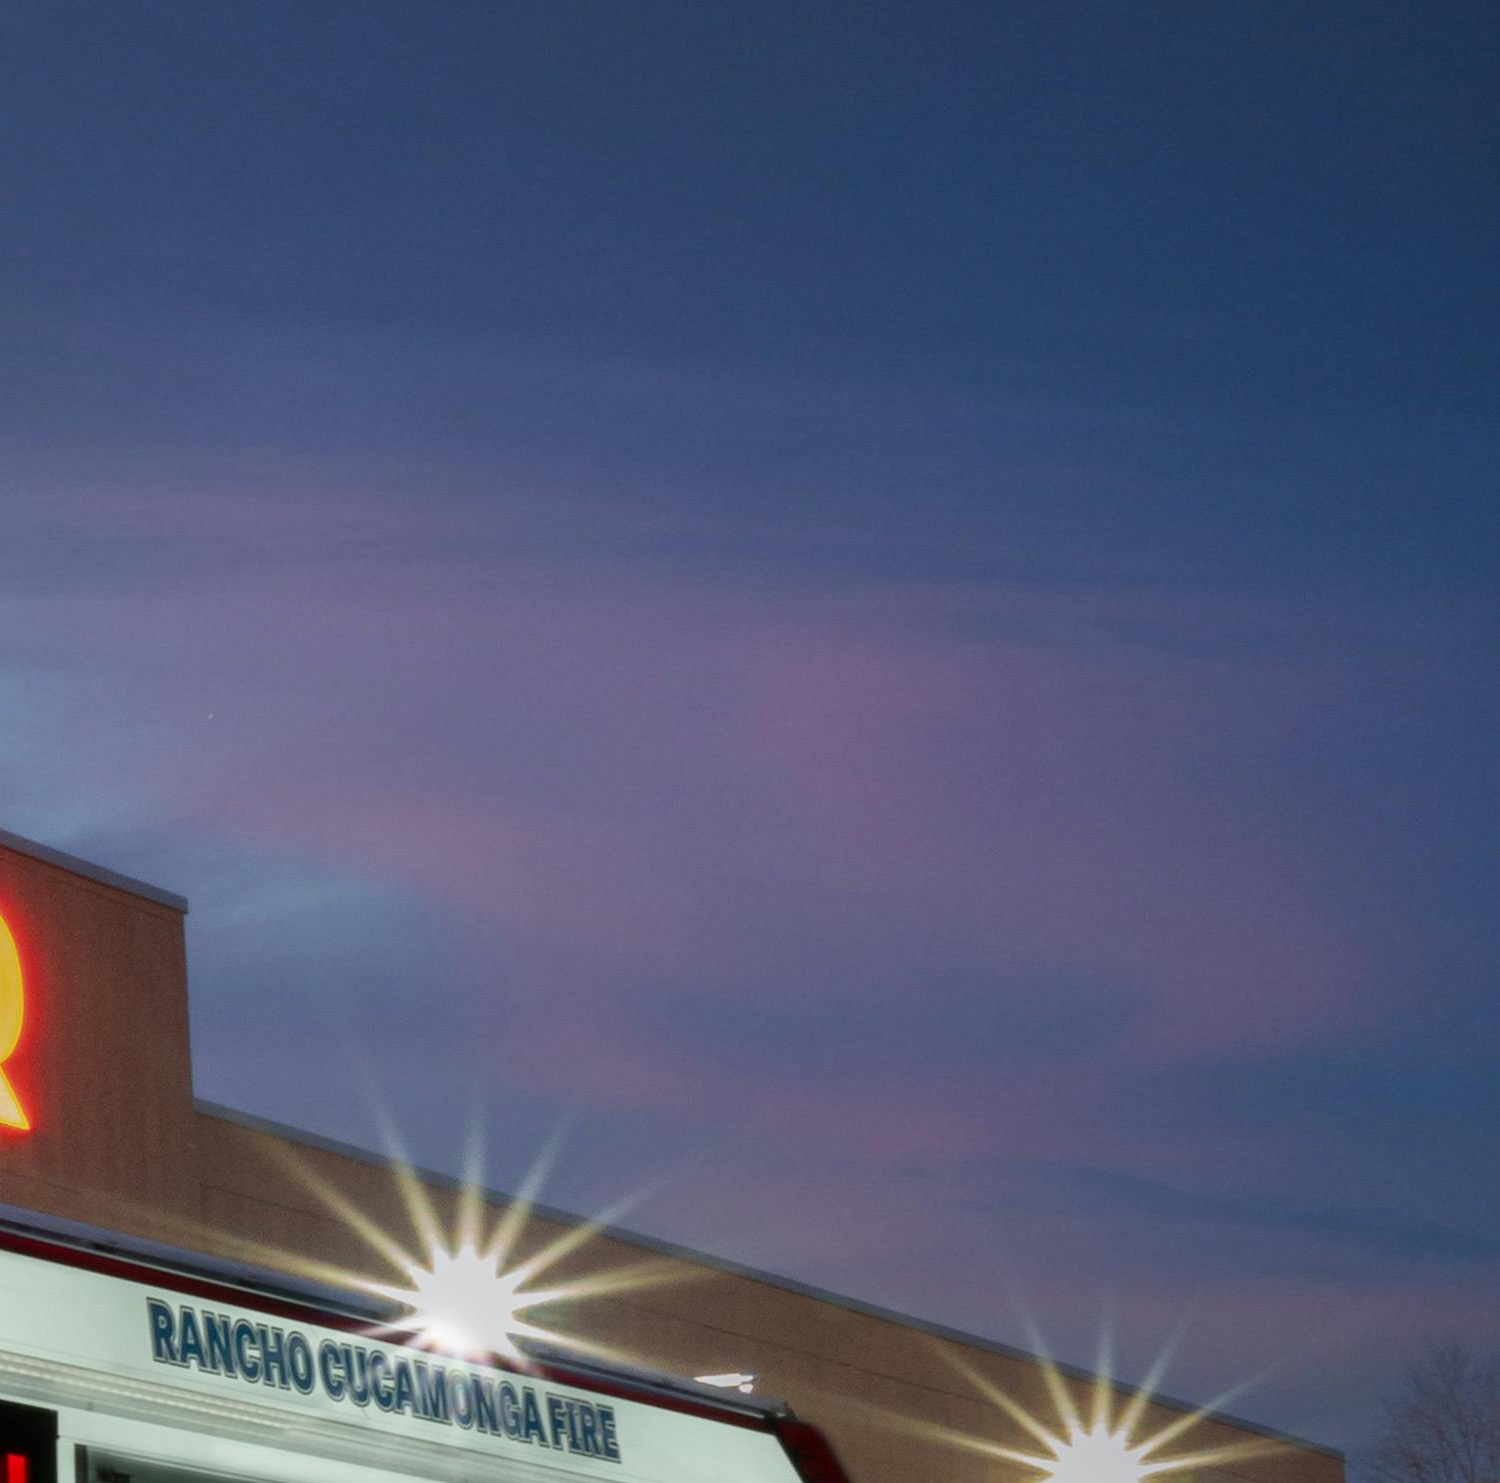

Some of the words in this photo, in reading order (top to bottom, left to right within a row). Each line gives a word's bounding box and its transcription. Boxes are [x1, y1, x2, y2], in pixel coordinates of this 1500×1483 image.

[145, 1296, 317, 1395] RANCHO
[318, 1339, 551, 1449] CUCAMONGA
[545, 1393, 622, 1463] FIRE
